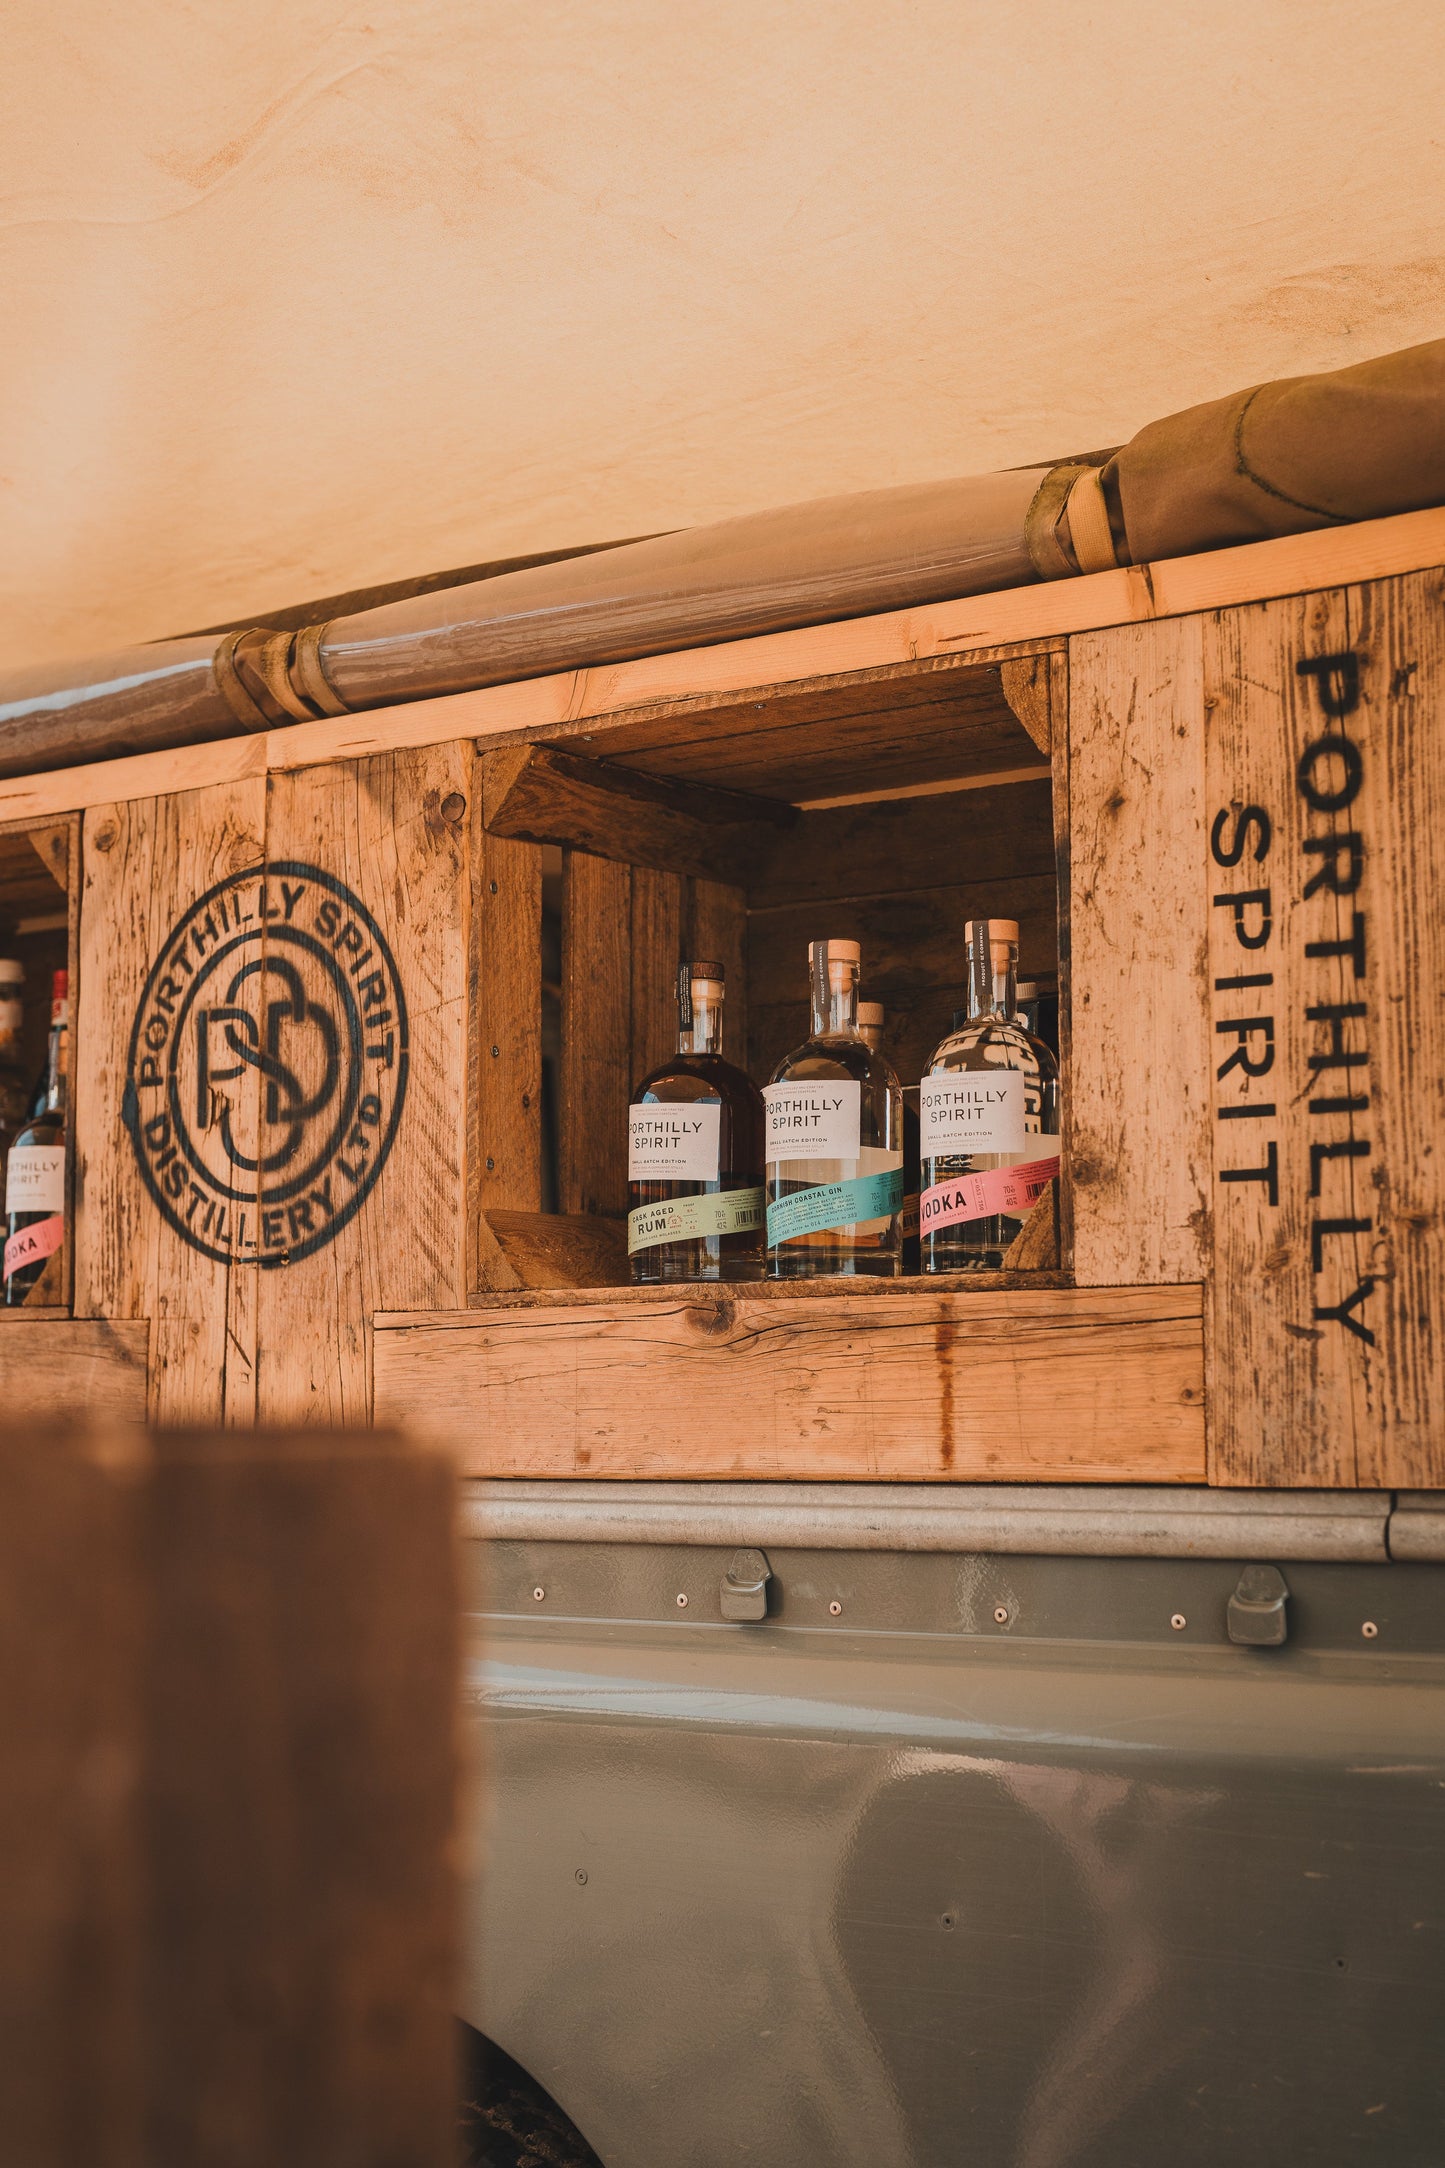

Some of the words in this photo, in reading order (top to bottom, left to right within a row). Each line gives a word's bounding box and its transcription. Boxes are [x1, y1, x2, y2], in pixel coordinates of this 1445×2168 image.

[141, 883, 305, 1088] PORTHILLY
[314, 900, 394, 1069] SPIRIT
[1211, 804, 1279, 1207] SPIRIT
[1297, 652, 1375, 1346] PORTHILLY
[772, 1115, 822, 1130] SPIRIT
[930, 1108, 984, 1124] SPIRIT
[634, 1137, 680, 1149] SPIRIT
[145, 1116, 334, 1249] DISTILLERY
[337, 1094, 382, 1184] LTD
[772, 1200, 792, 1213] CORNISH
[794, 1192, 826, 1204] COASTAL
[829, 1186, 842, 1195] GIN
[921, 1190, 967, 1222] VODKA
[632, 1212, 648, 1223] CASK
[650, 1207, 674, 1217] AGED
[638, 1218, 666, 1235] RUM
[7, 1236, 38, 1262] ODKA
